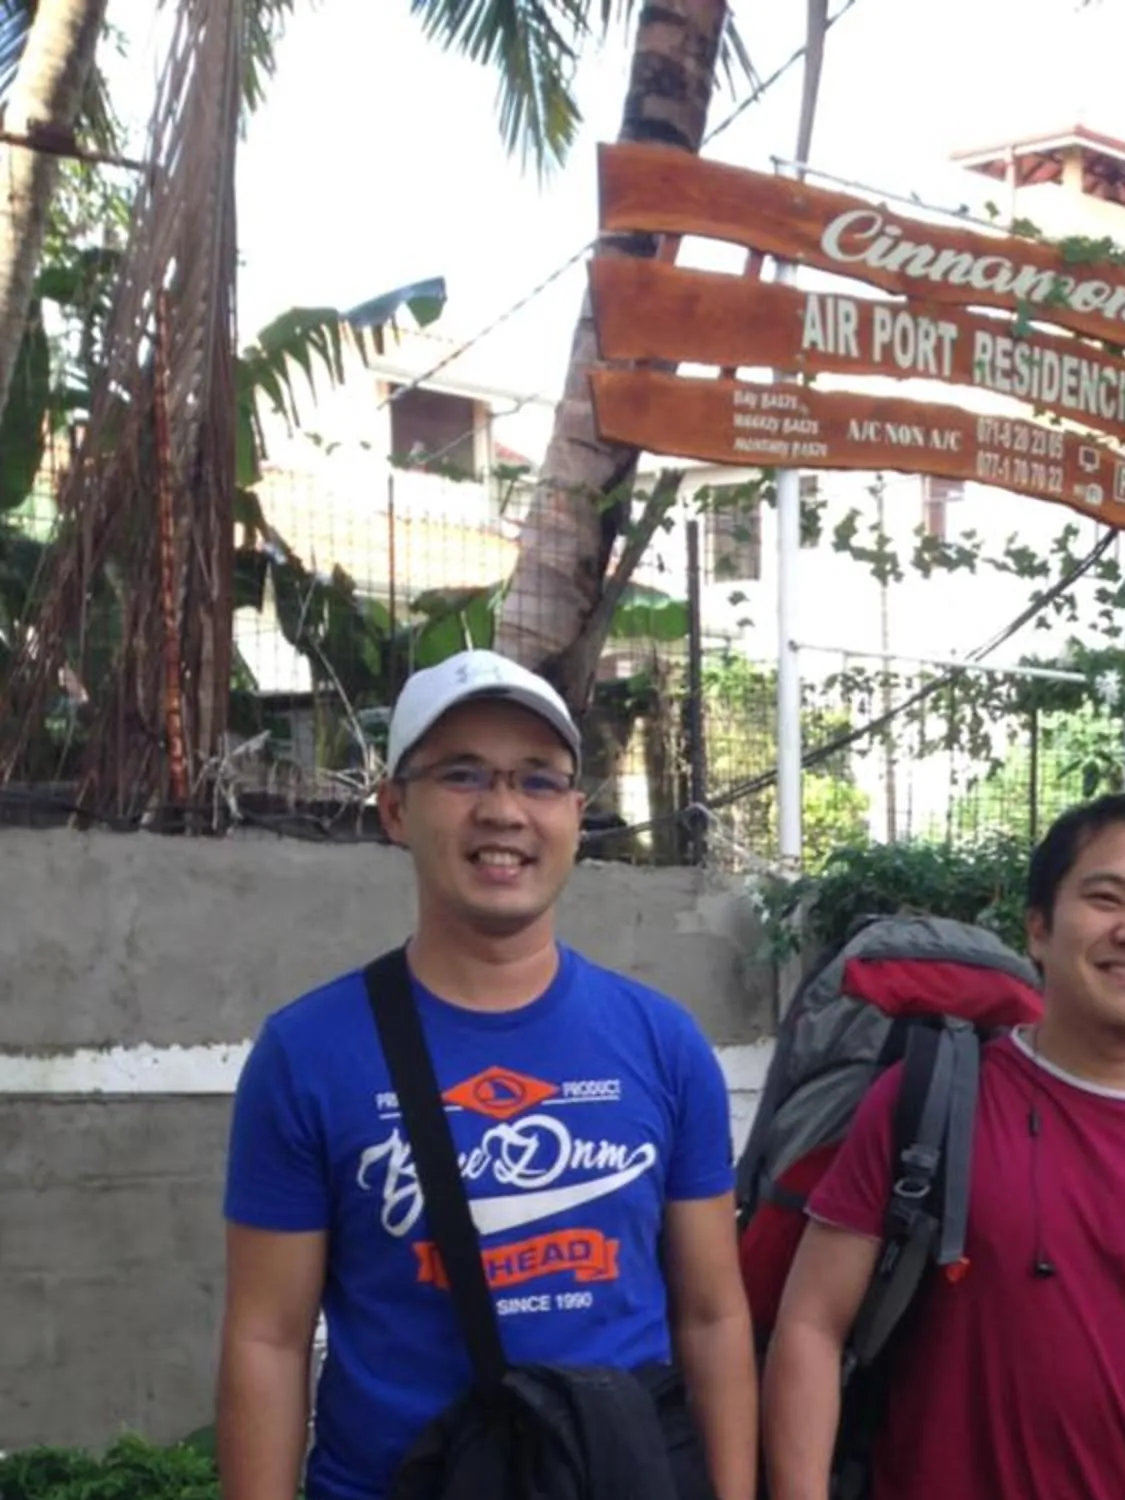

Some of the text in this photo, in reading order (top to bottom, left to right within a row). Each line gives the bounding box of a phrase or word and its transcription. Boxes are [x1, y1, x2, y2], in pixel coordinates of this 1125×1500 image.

[802, 294, 859, 357] AIR
[872, 306, 958, 376] PORT
[848, 418, 963, 452] A/C NON A/C
[488, 1240, 591, 1283] HEAD
[496, 1292, 593, 1316] SINCE 1990
